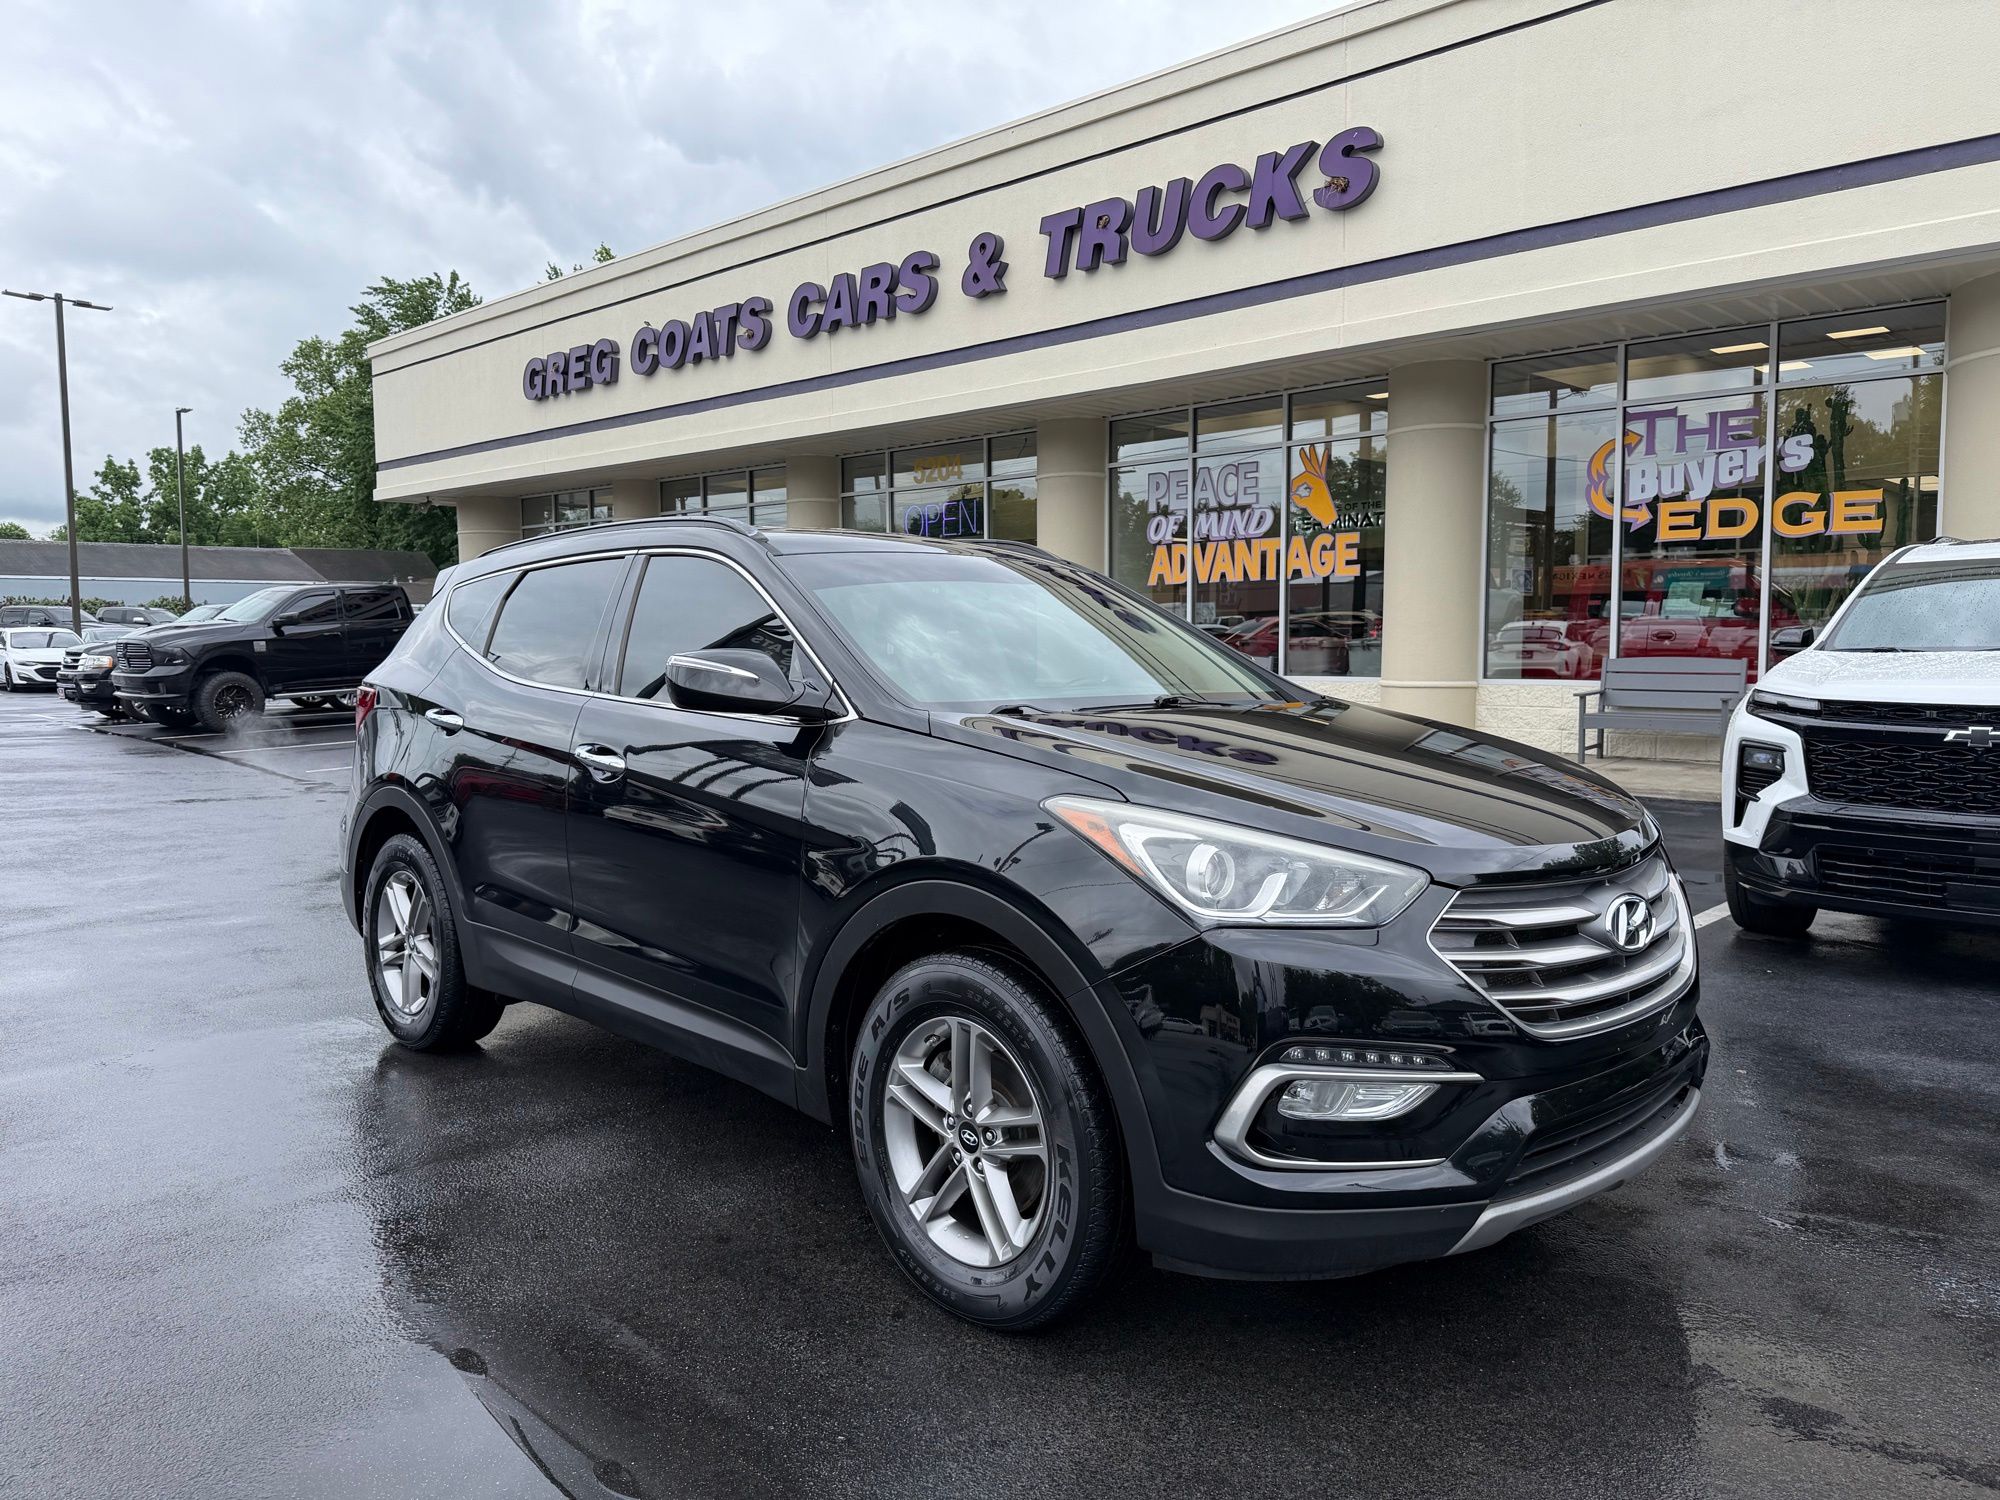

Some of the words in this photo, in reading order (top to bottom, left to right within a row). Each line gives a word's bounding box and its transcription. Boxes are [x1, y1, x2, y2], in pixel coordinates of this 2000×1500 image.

[522, 338, 620, 402] GREG
[630, 296, 774, 377] COATS
[787, 250, 941, 340] CARS
[961, 231, 1009, 299] &
[1039, 126, 1385, 280] TRUCKS
[1625, 406, 1761, 457] THE
[912, 454, 963, 485] 5204
[1147, 461, 1260, 514] PEACE
[904, 498, 977, 537] OPEN
[1147, 513, 1185, 545] OF
[1193, 507, 1274, 542] MIND
[1654, 487, 1885, 544] EDGE
[1147, 532, 1361, 587] ADVANTAGE
[854, 1050, 870, 1169] EDGE
[871, 988, 910, 1042] A/S
[1024, 1143, 1073, 1301] KELLY
